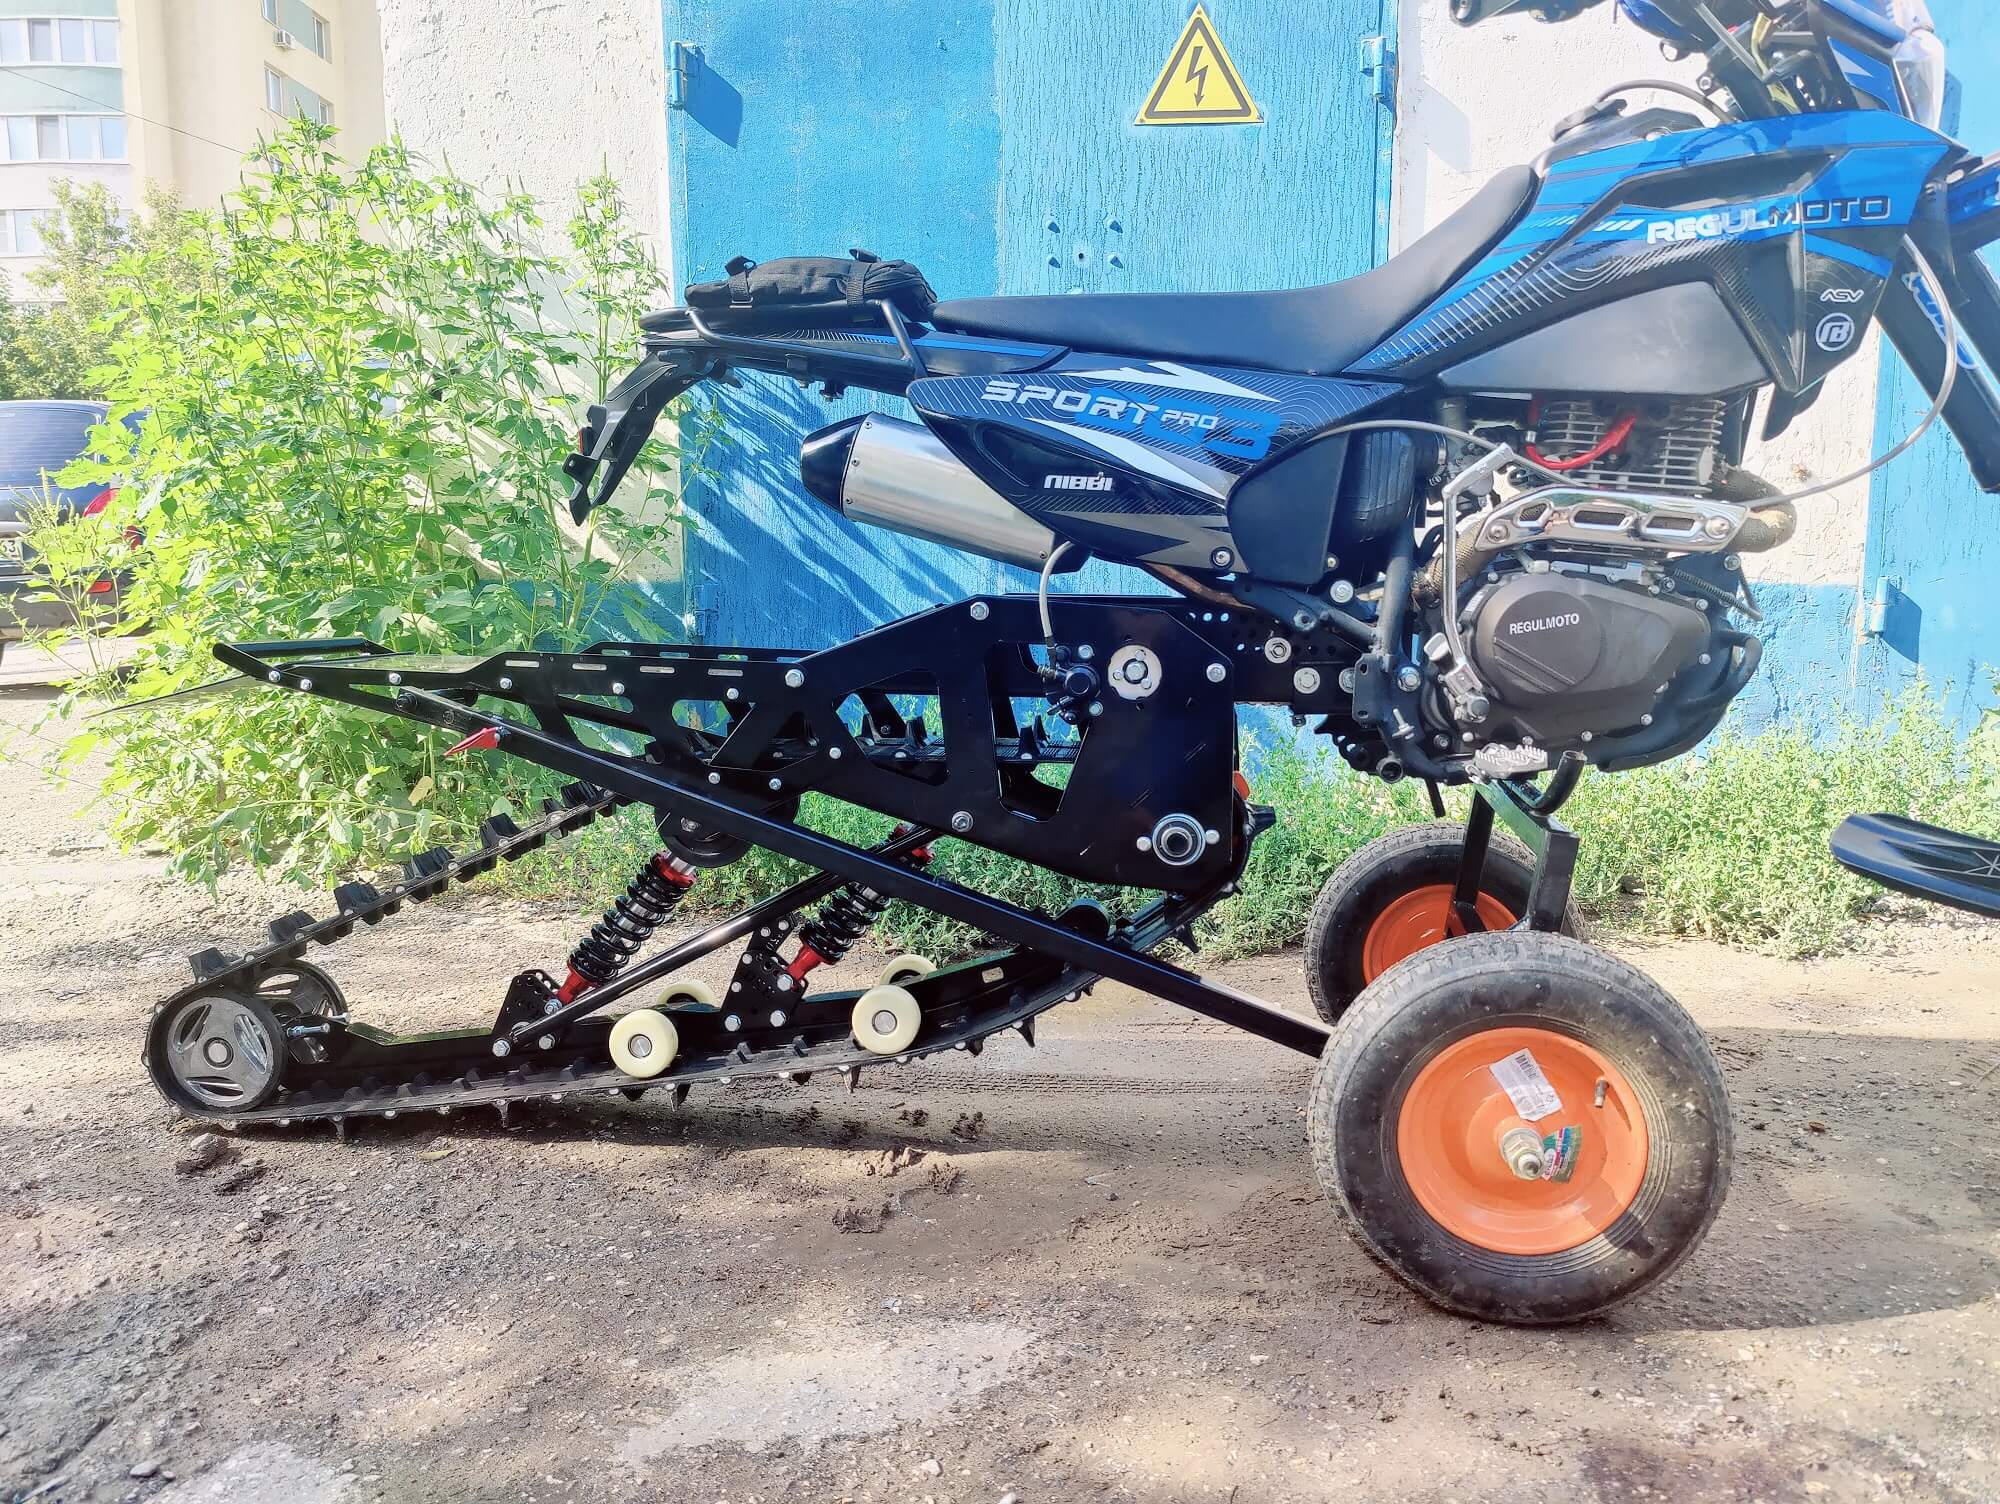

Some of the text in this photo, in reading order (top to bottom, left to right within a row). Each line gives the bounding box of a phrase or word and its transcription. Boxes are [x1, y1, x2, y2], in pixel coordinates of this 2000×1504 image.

[1646, 195, 1891, 245] REGULMOTO
[1820, 288, 1865, 303] ASV
[981, 380, 1220, 430] SPORT PRO
[1509, 612, 1581, 636] REGULMOTO
